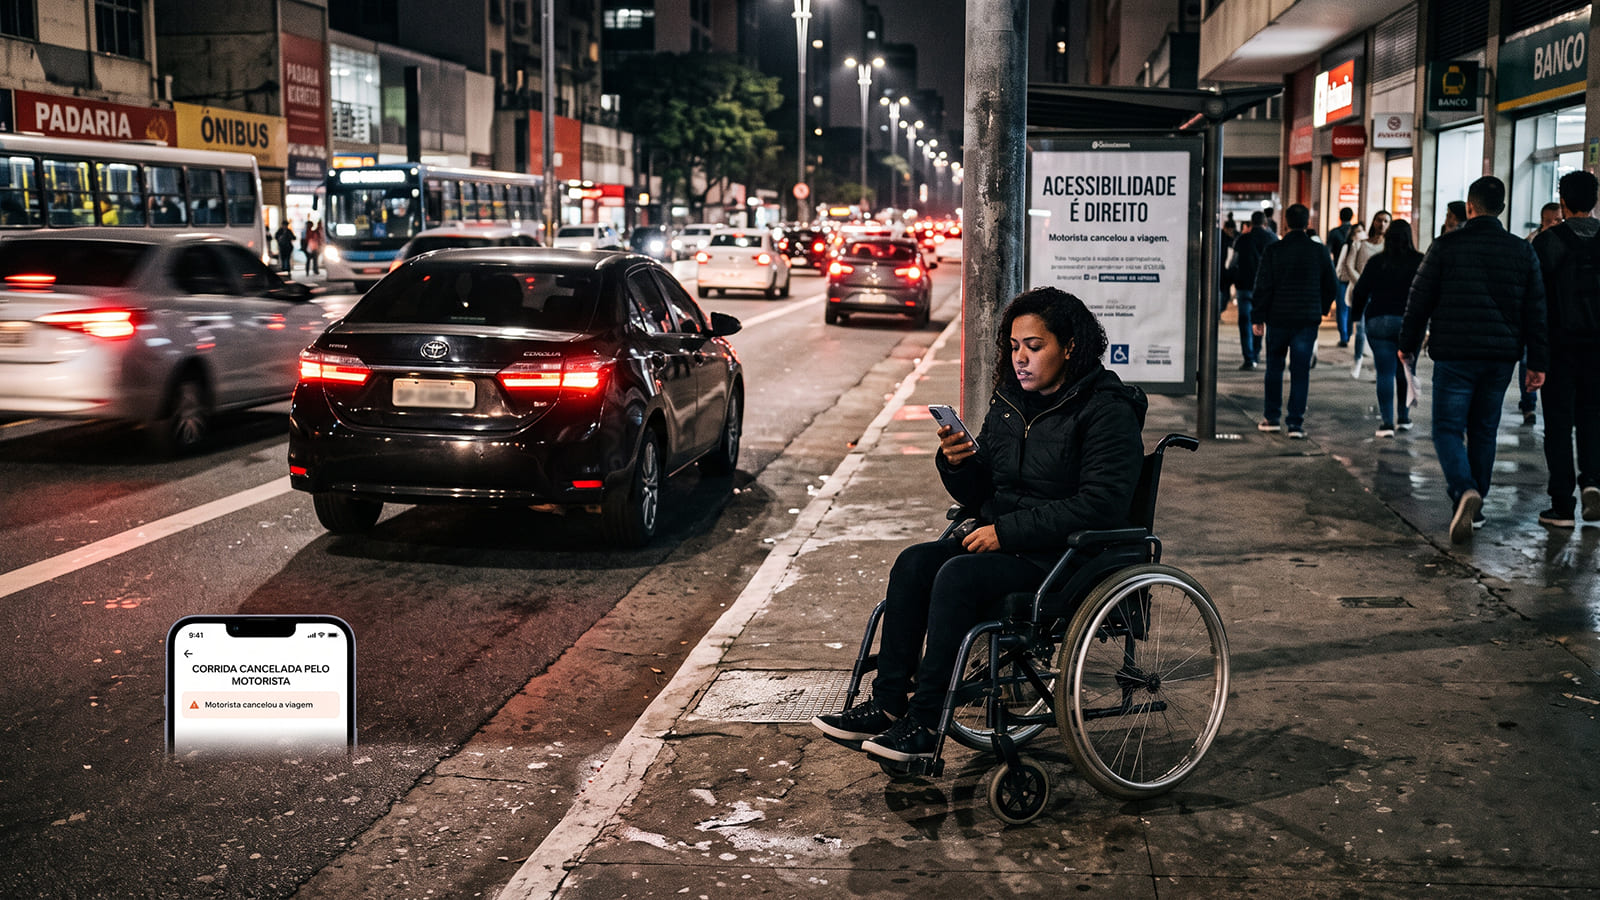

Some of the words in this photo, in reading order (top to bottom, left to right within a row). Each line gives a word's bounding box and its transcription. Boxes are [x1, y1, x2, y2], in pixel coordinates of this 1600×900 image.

[1533, 32, 1585, 80] BANCO
[1438, 98, 1468, 106] BANCO
[35, 101, 132, 139] PADARIA
[1042, 176, 1177, 196] ACESSIBILIDADE
[1070, 198, 1080, 222] É
[1084, 202, 1148, 222] DIREITO
[1048, 234, 1088, 242] Motorista
[1090, 234, 1128, 242] cancelou
[1136, 234, 1169, 244] viagem.
